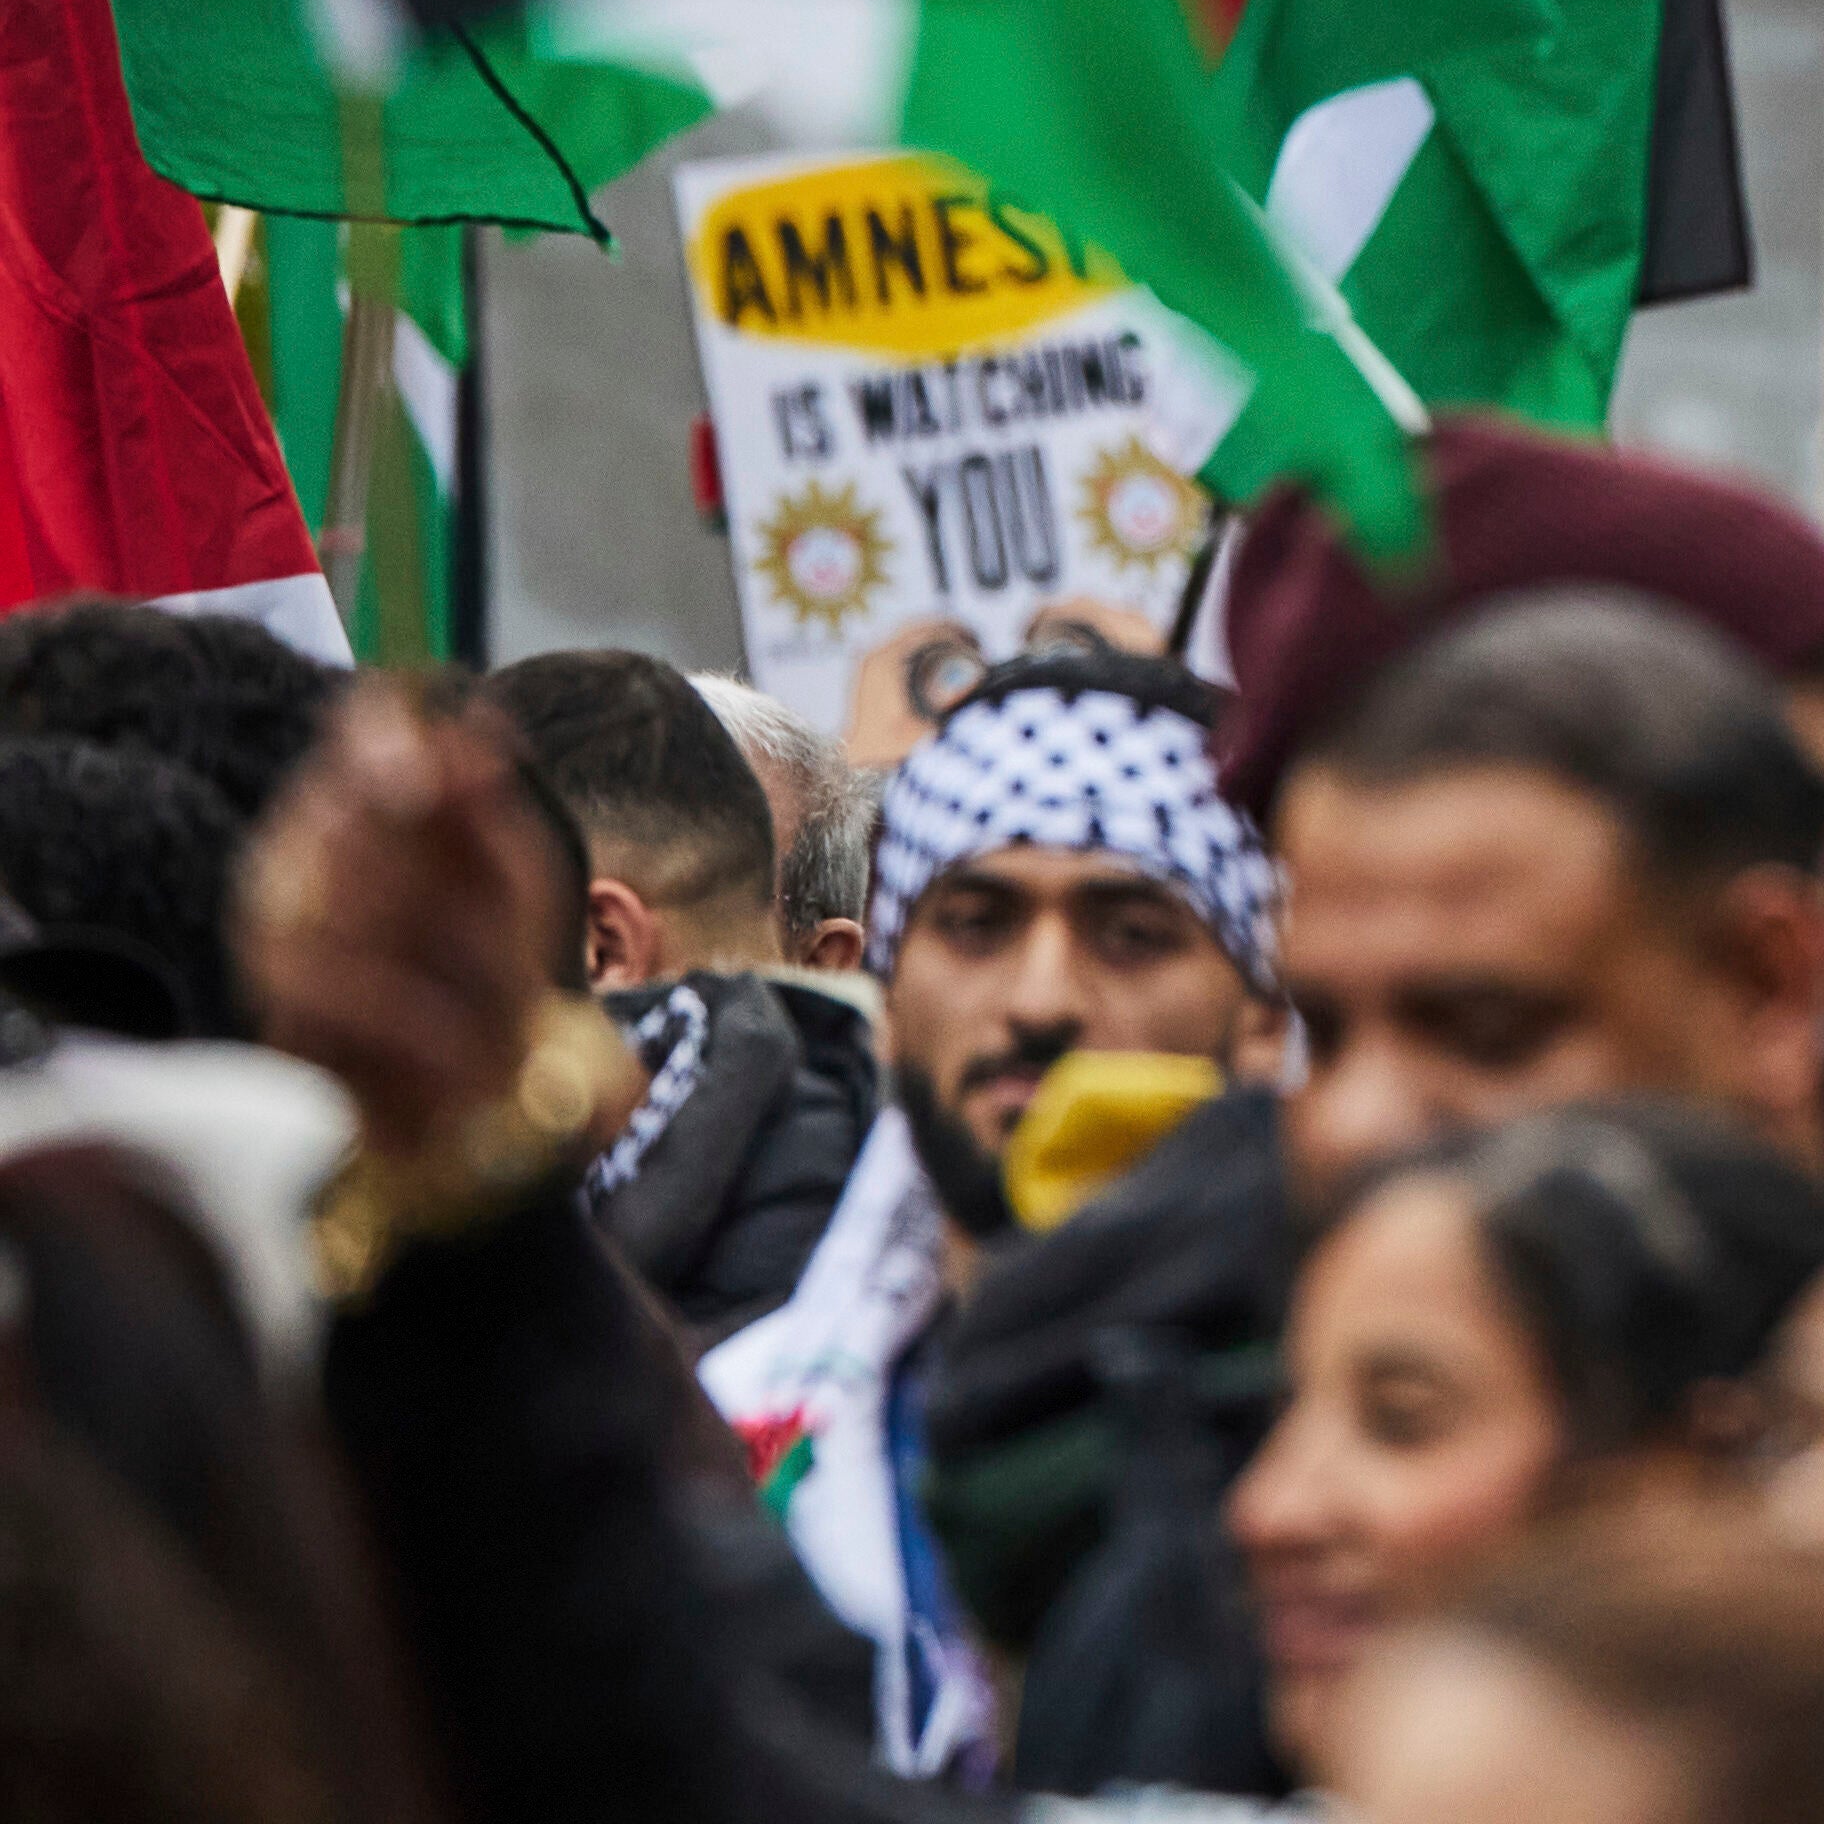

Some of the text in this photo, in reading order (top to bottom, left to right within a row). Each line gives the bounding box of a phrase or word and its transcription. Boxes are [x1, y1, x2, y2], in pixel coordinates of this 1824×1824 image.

[771, 327, 1150, 461] IS WATCHING
[898, 444, 1062, 594] YOU
